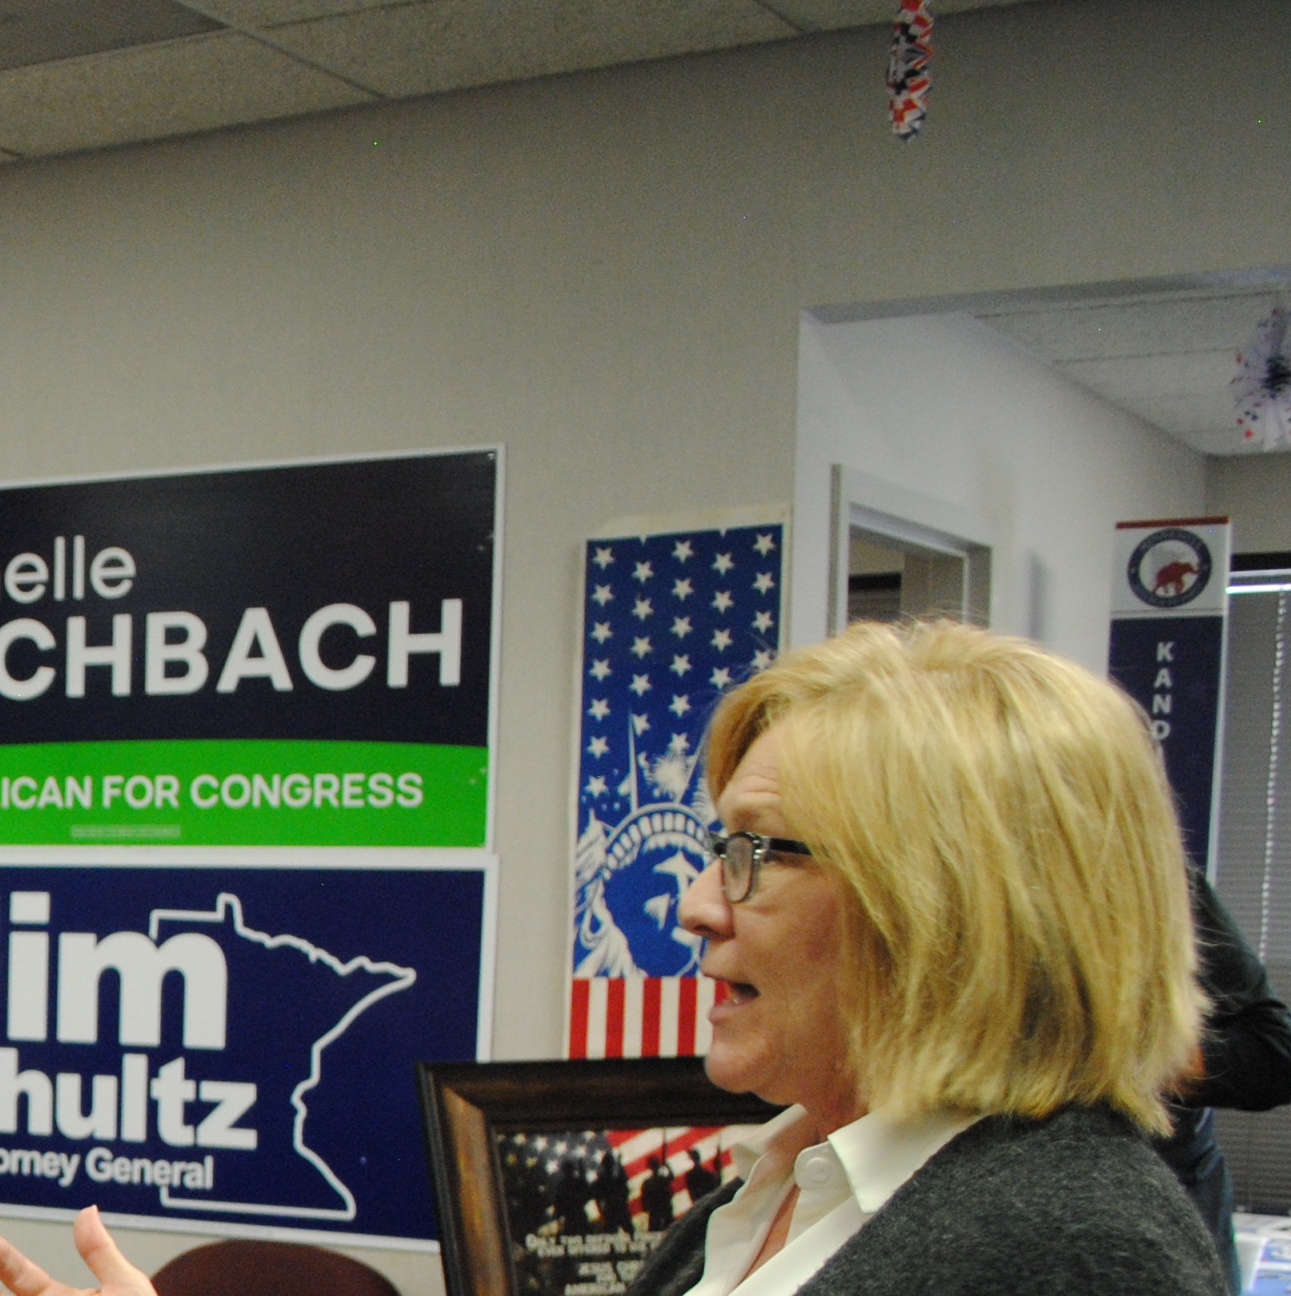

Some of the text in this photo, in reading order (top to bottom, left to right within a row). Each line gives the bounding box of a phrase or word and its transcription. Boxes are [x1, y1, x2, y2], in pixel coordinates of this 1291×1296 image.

[103, 774, 180, 810] FOR
[190, 772, 424, 809] CONGRESS
[86, 1146, 215, 1190] General
